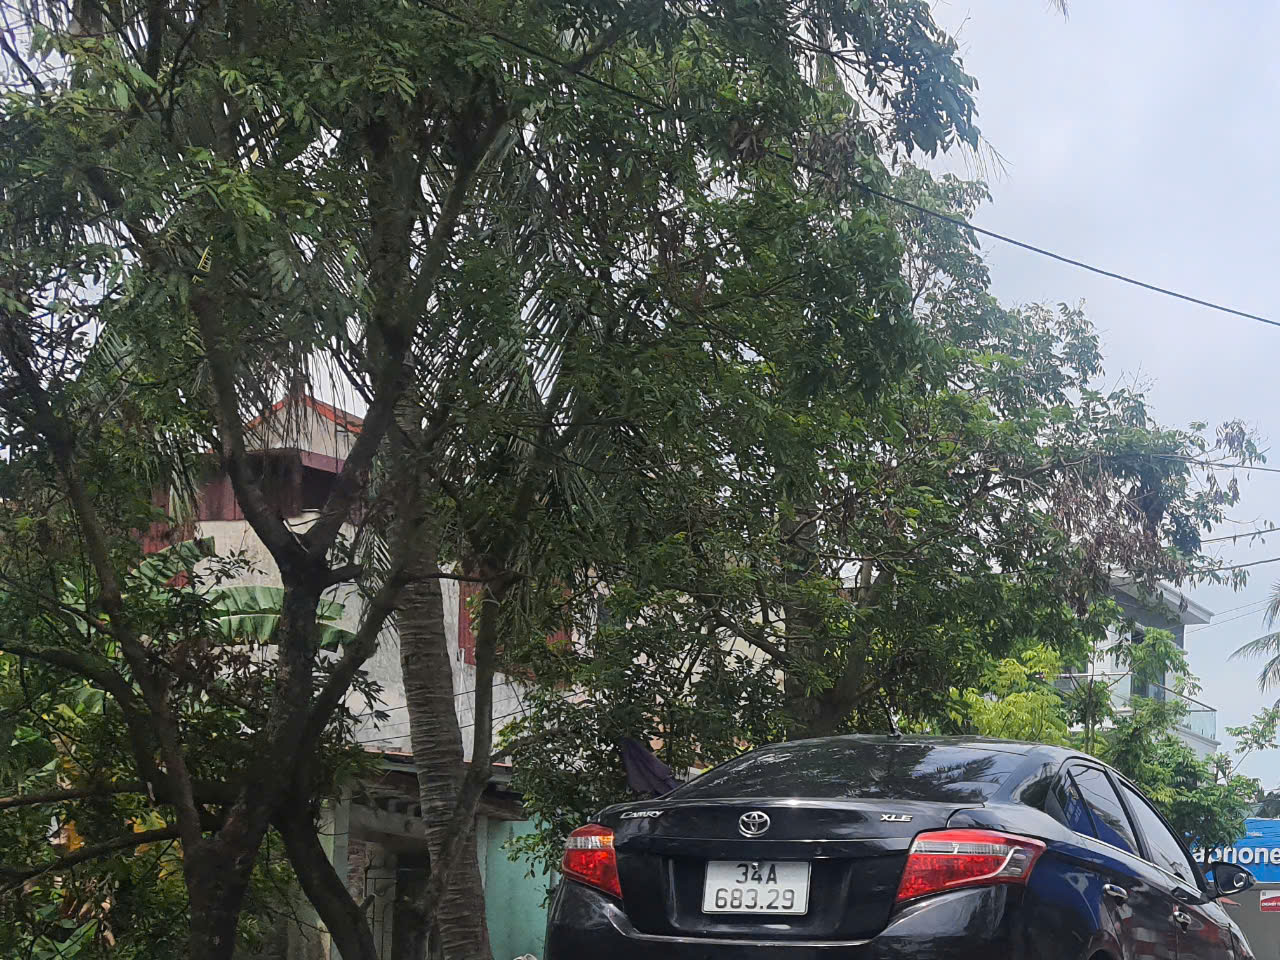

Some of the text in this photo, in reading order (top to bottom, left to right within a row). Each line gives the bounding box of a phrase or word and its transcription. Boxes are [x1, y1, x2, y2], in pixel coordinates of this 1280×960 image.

[880, 814, 912, 822] XLE
[736, 863, 777, 885] 34A
[715, 888, 795, 910] 683.29
